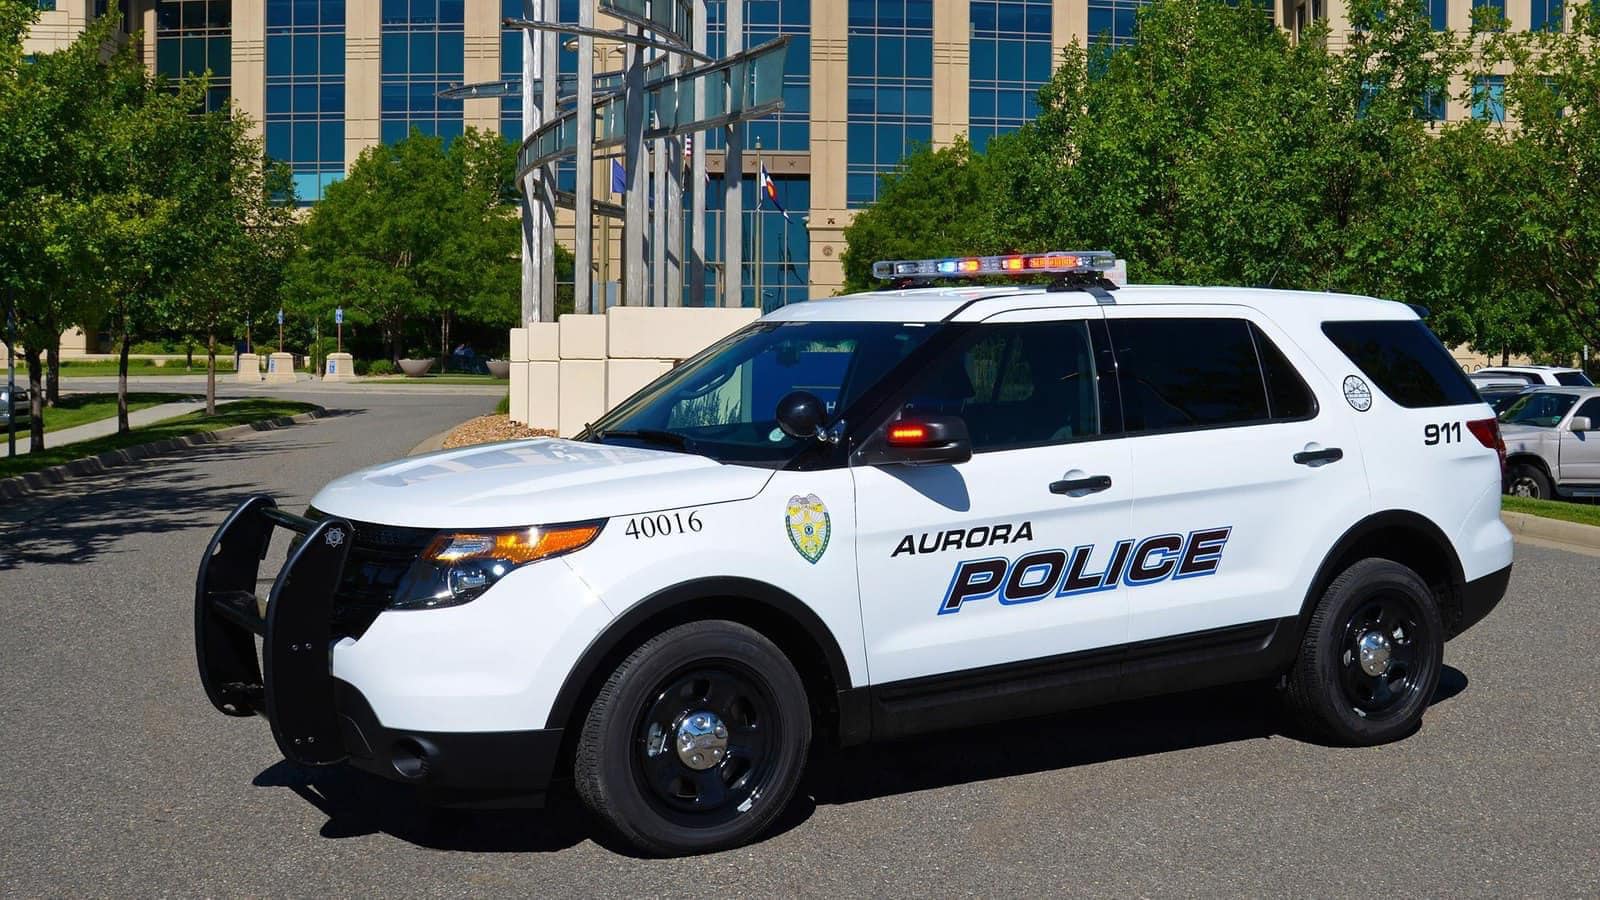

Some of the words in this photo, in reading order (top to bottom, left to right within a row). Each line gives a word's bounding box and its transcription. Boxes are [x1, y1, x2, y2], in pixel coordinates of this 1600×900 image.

[1424, 421, 1461, 446] 911
[625, 510, 703, 540] 40016
[891, 521, 1033, 558] AURORA
[937, 526, 1233, 616] POLICE
